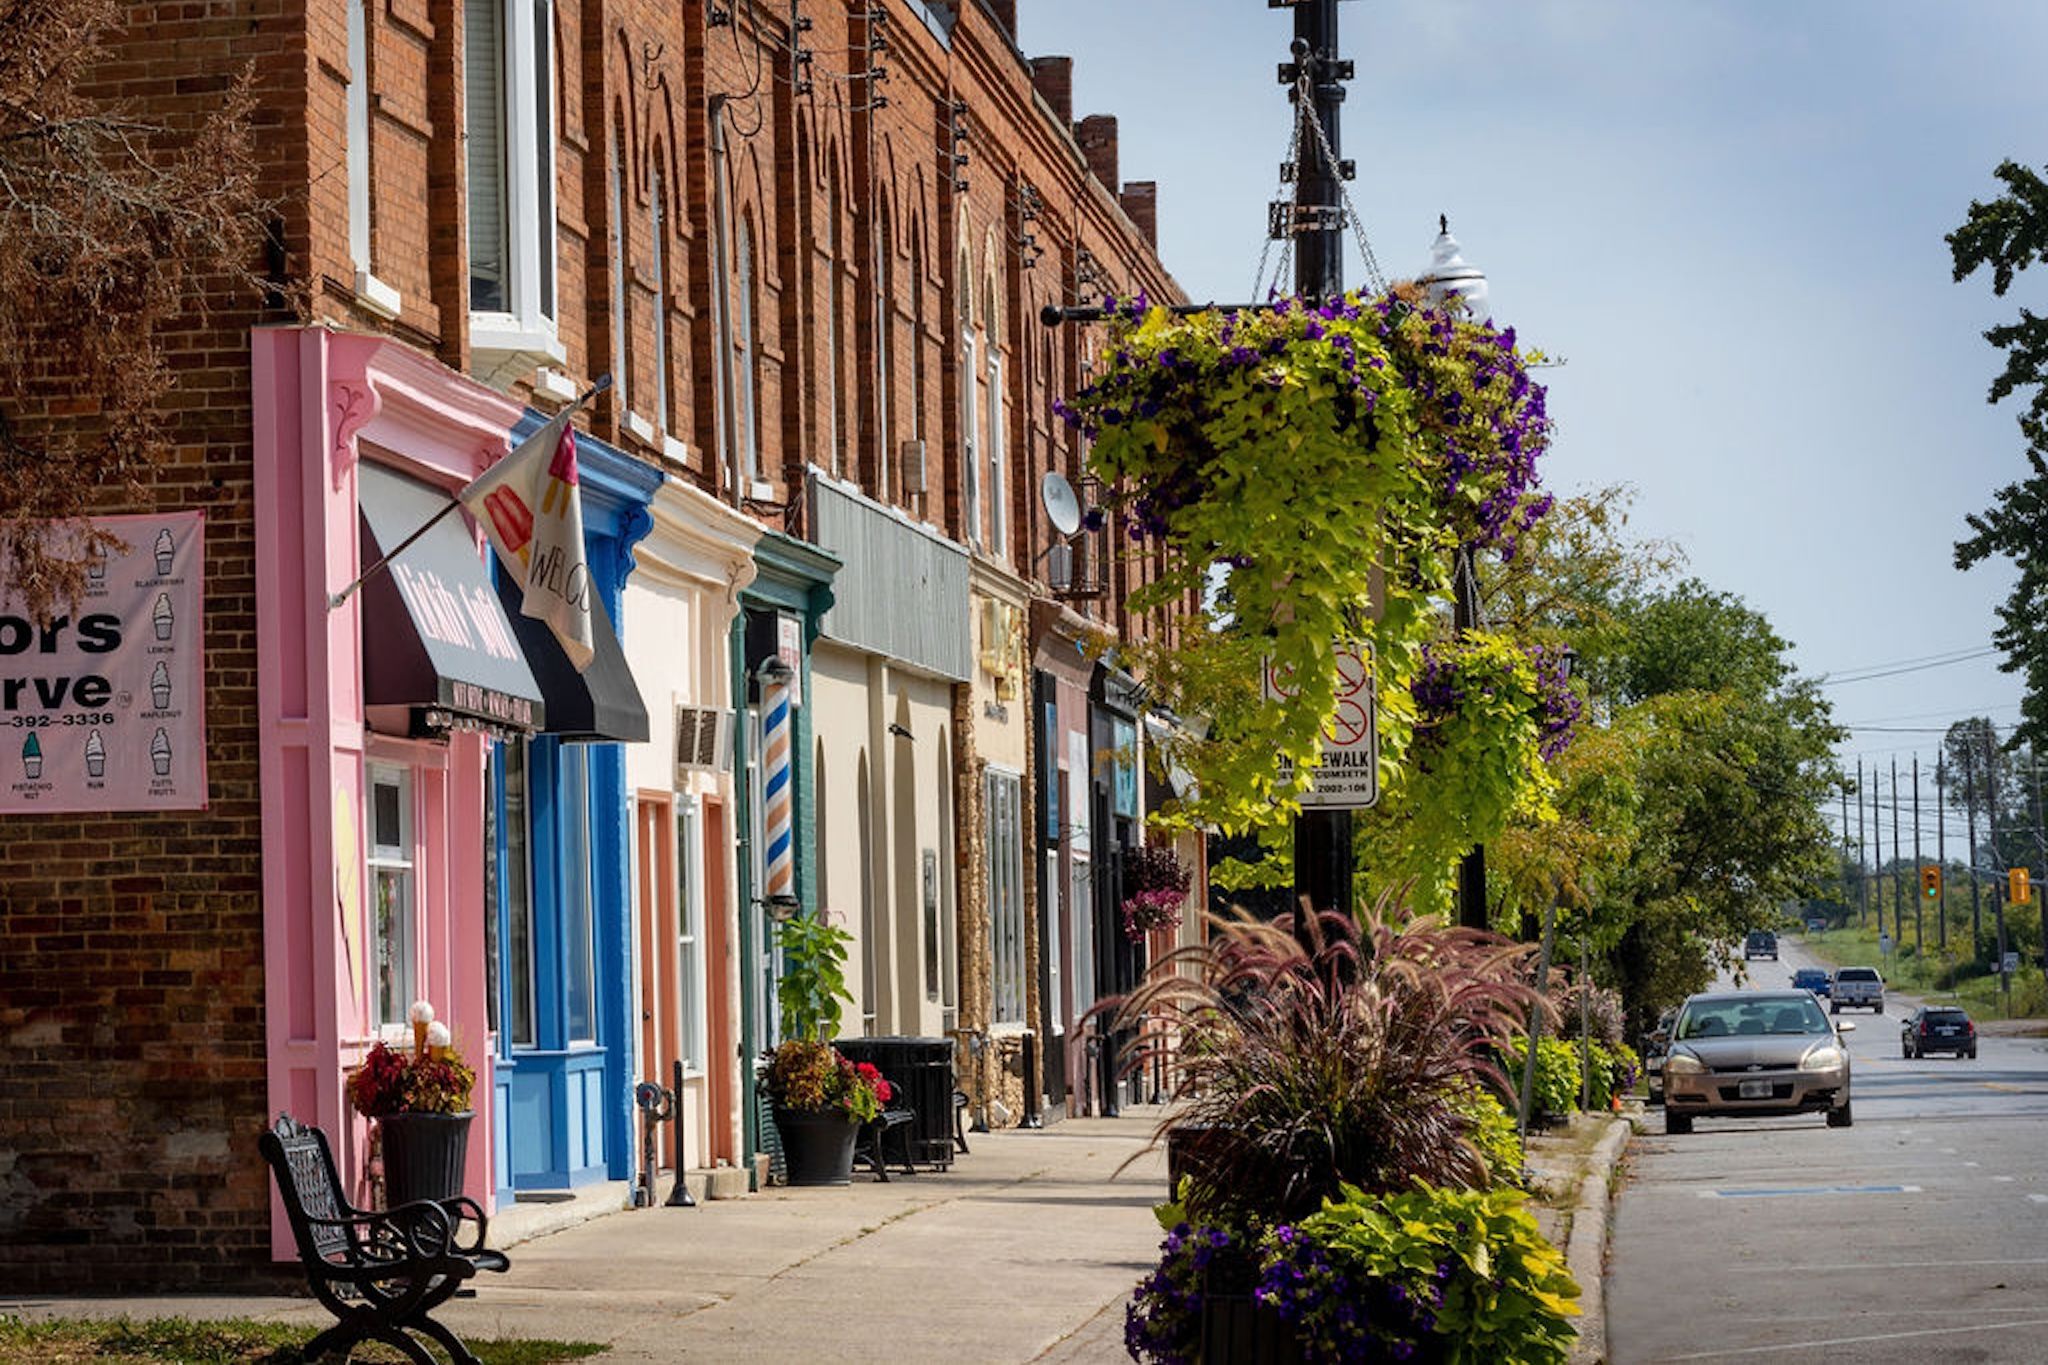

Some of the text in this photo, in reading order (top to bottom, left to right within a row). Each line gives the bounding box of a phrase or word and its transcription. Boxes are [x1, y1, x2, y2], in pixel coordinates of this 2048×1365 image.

[4, 675, 112, 711] rve
[1315, 771, 1368, 779] CUMSETH
[12, 782, 52, 791] PISTACHIO
[152, 779, 173, 787] TUTTI
[149, 788, 176, 796] FRUTTI
